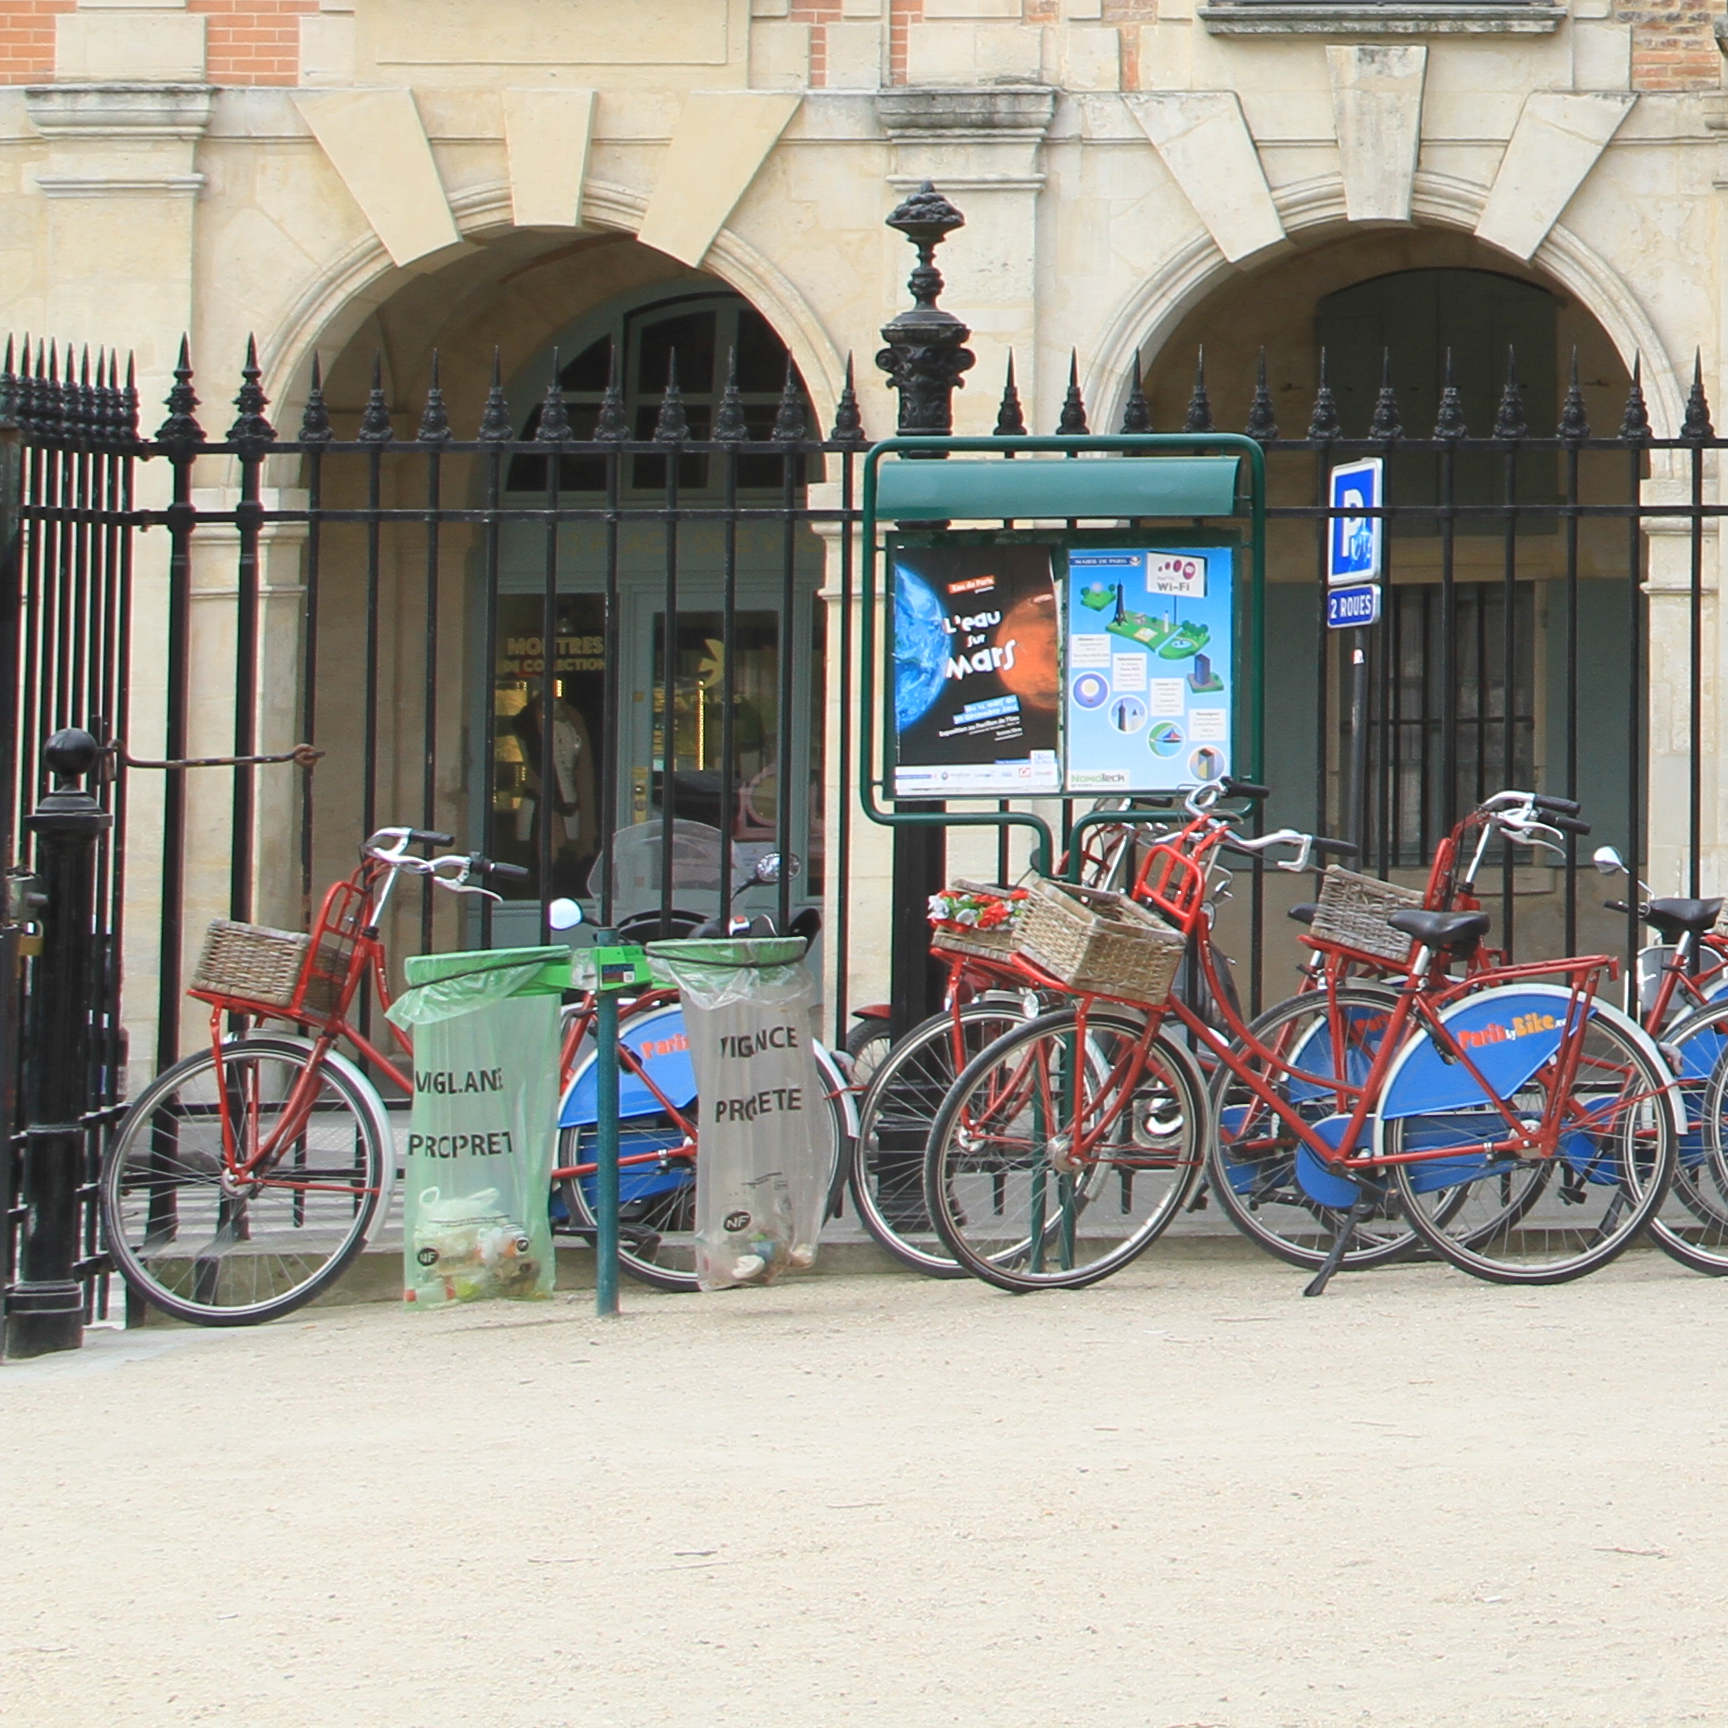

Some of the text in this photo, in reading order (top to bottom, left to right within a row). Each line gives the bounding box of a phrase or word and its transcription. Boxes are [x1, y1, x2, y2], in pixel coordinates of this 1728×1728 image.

[1341, 488, 1365, 558] P
[589, 531, 683, 556] PACE
[1157, 582, 1190, 591] Wi-Fi
[1330, 594, 1372, 619] 2 ROUES
[944, 610, 1001, 634] L'eau
[507, 636, 604, 655] MOTRES
[945, 639, 1016, 680] Mars
[690, 693, 742, 704] PARS
[726, 1215, 749, 1228] NF
